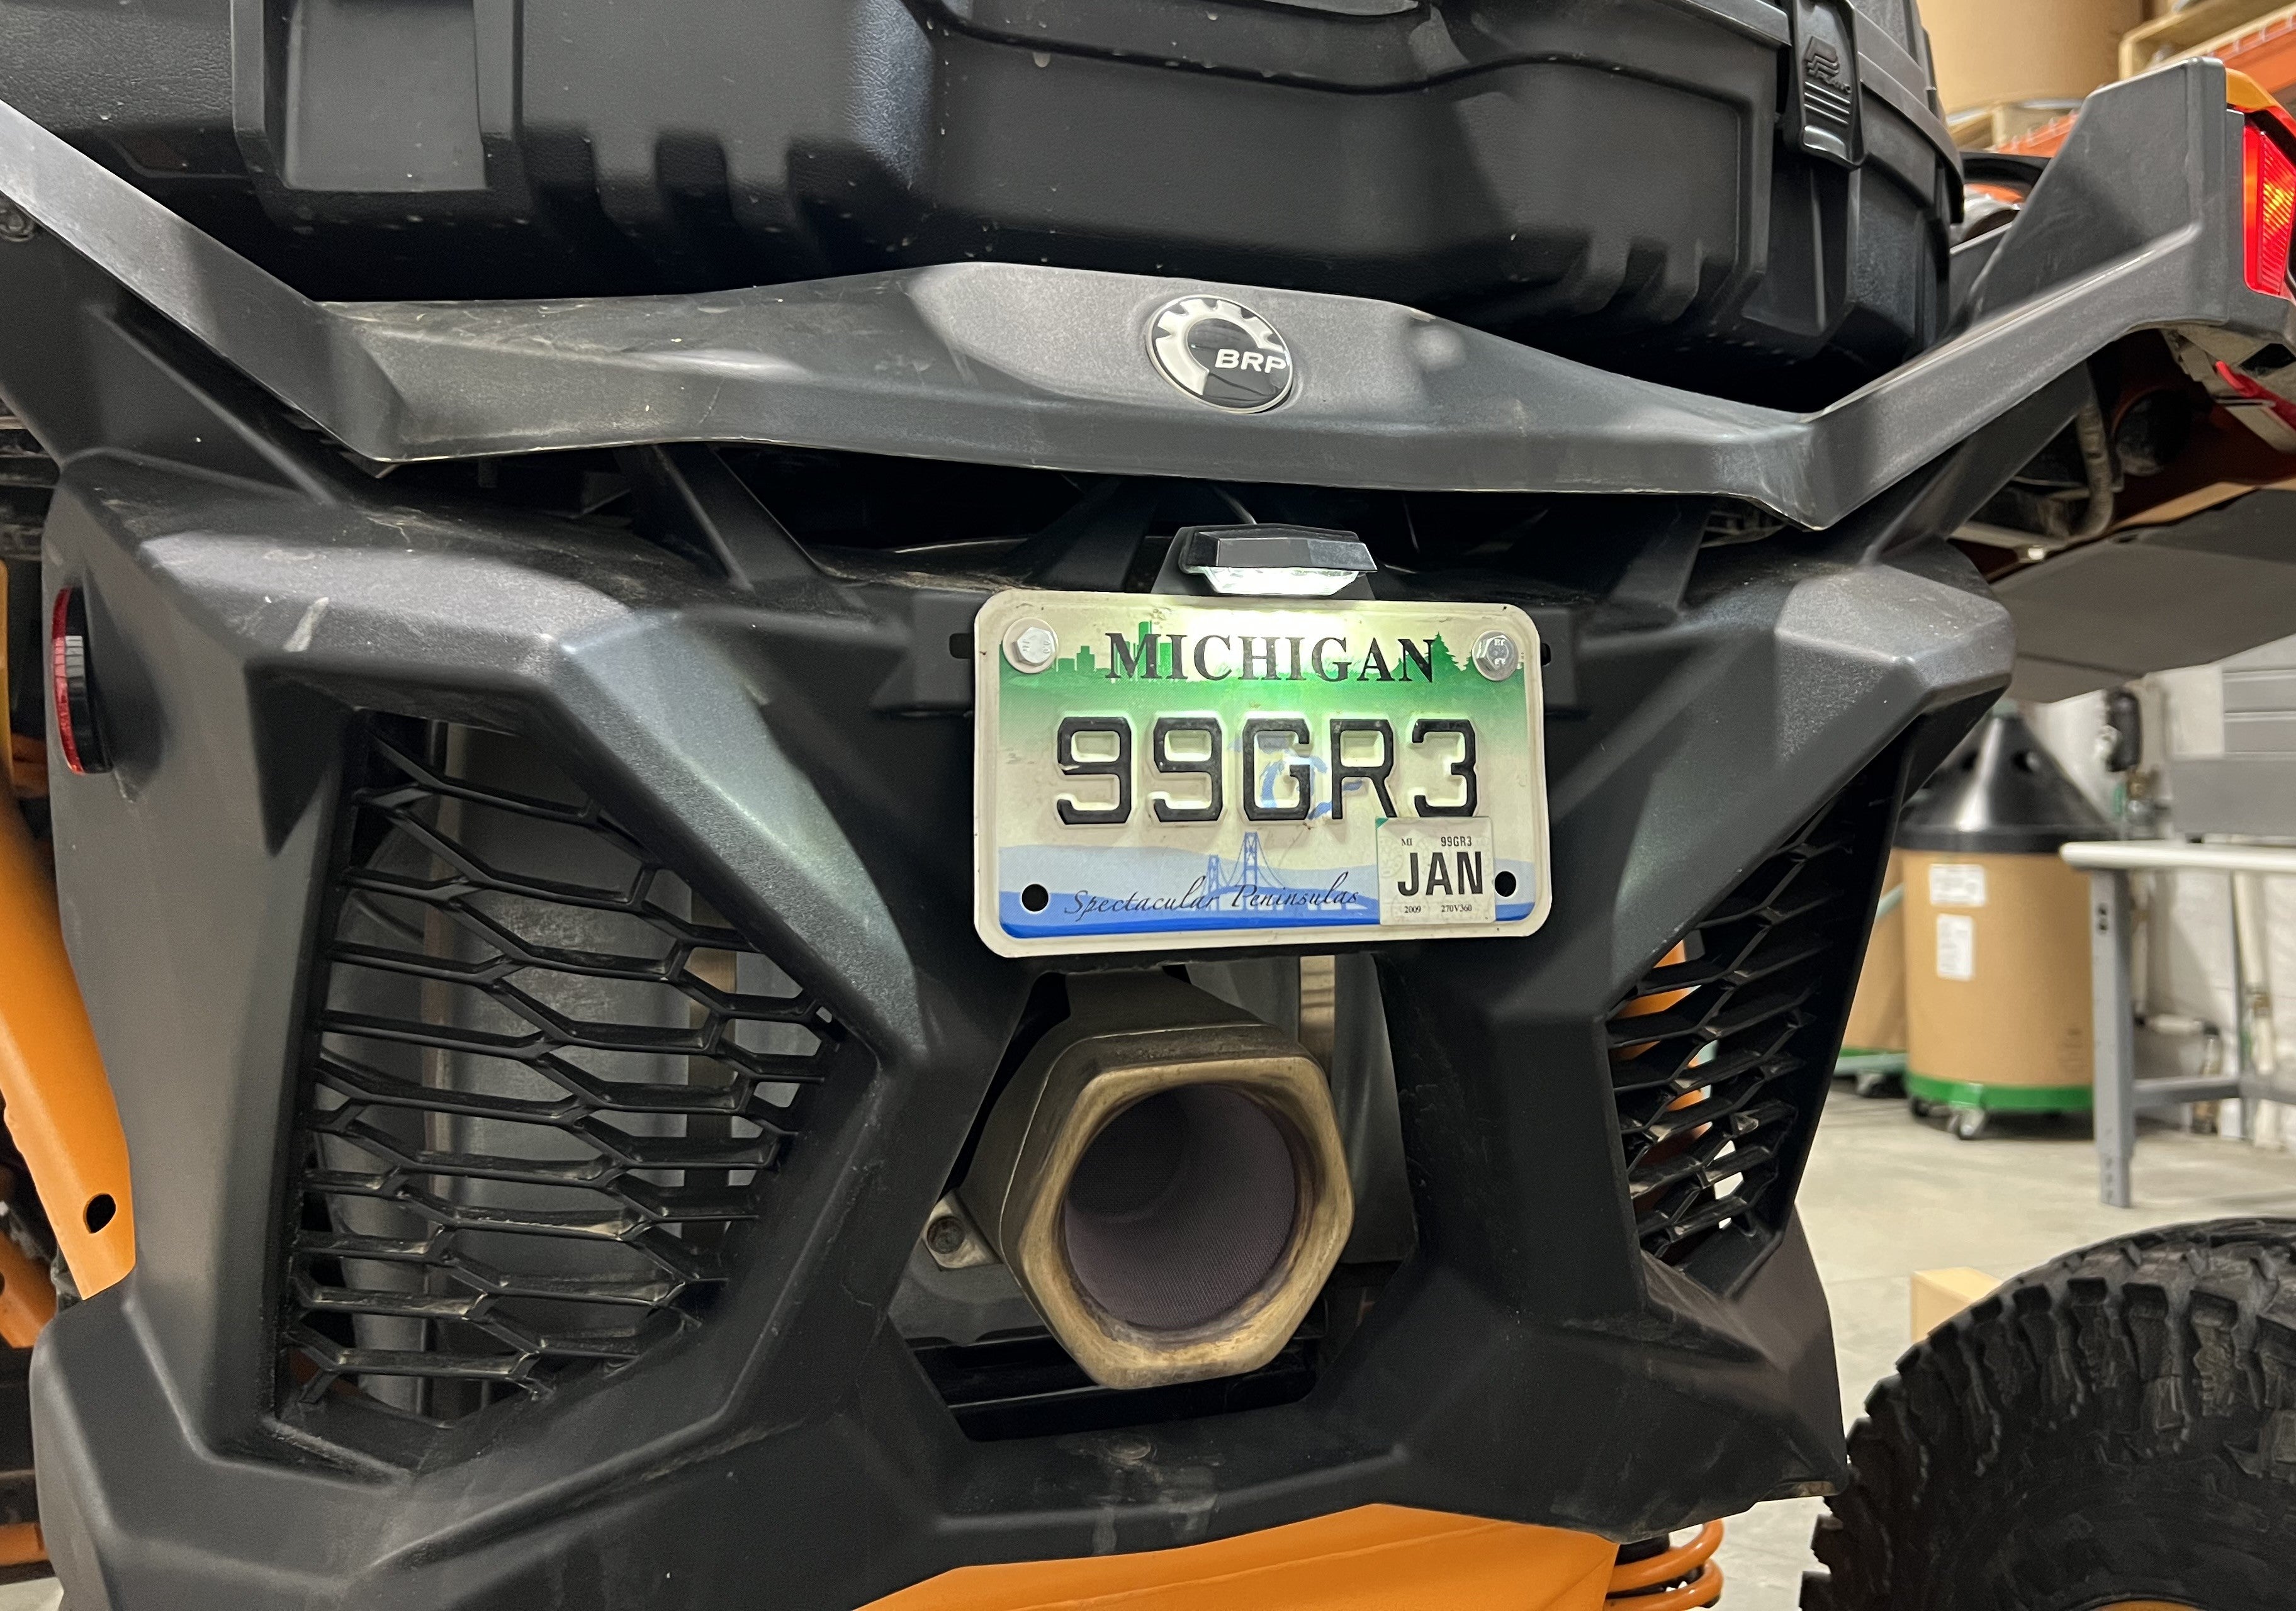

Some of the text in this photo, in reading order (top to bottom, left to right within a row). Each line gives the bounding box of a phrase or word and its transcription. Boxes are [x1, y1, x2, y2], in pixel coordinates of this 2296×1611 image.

[1215, 349, 1287, 373] BRP
[1105, 632, 1435, 684] MICHIGAN
[1056, 716, 1477, 825] 99GR3
[1401, 836, 1472, 847] MI 99GR3
[1064, 871, 1359, 922] Spectacular Peninsulas
[1397, 851, 1483, 896] JAN
